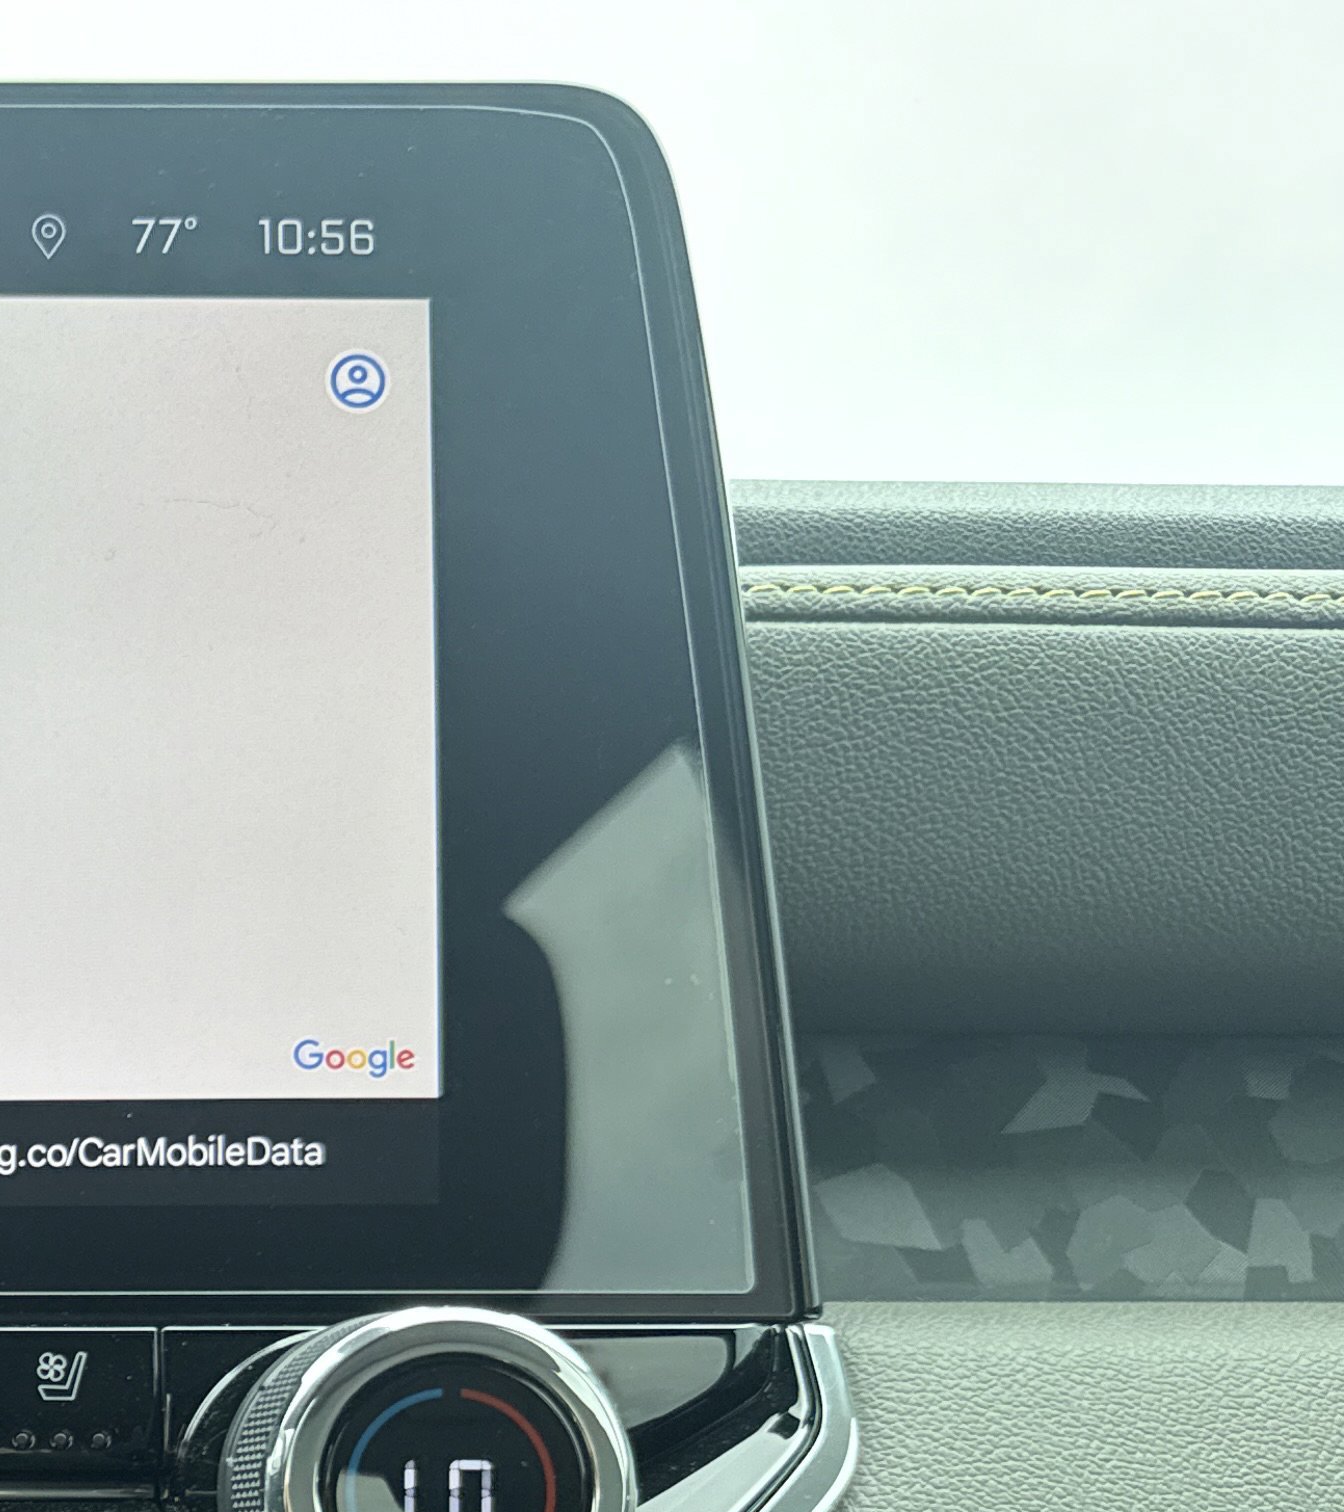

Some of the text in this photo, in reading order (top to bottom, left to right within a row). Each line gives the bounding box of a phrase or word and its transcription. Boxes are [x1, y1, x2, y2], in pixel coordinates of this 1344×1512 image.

[131, 216, 199, 255] 77°
[259, 219, 376, 256] 10:56
[293, 1039, 416, 1079] Google
